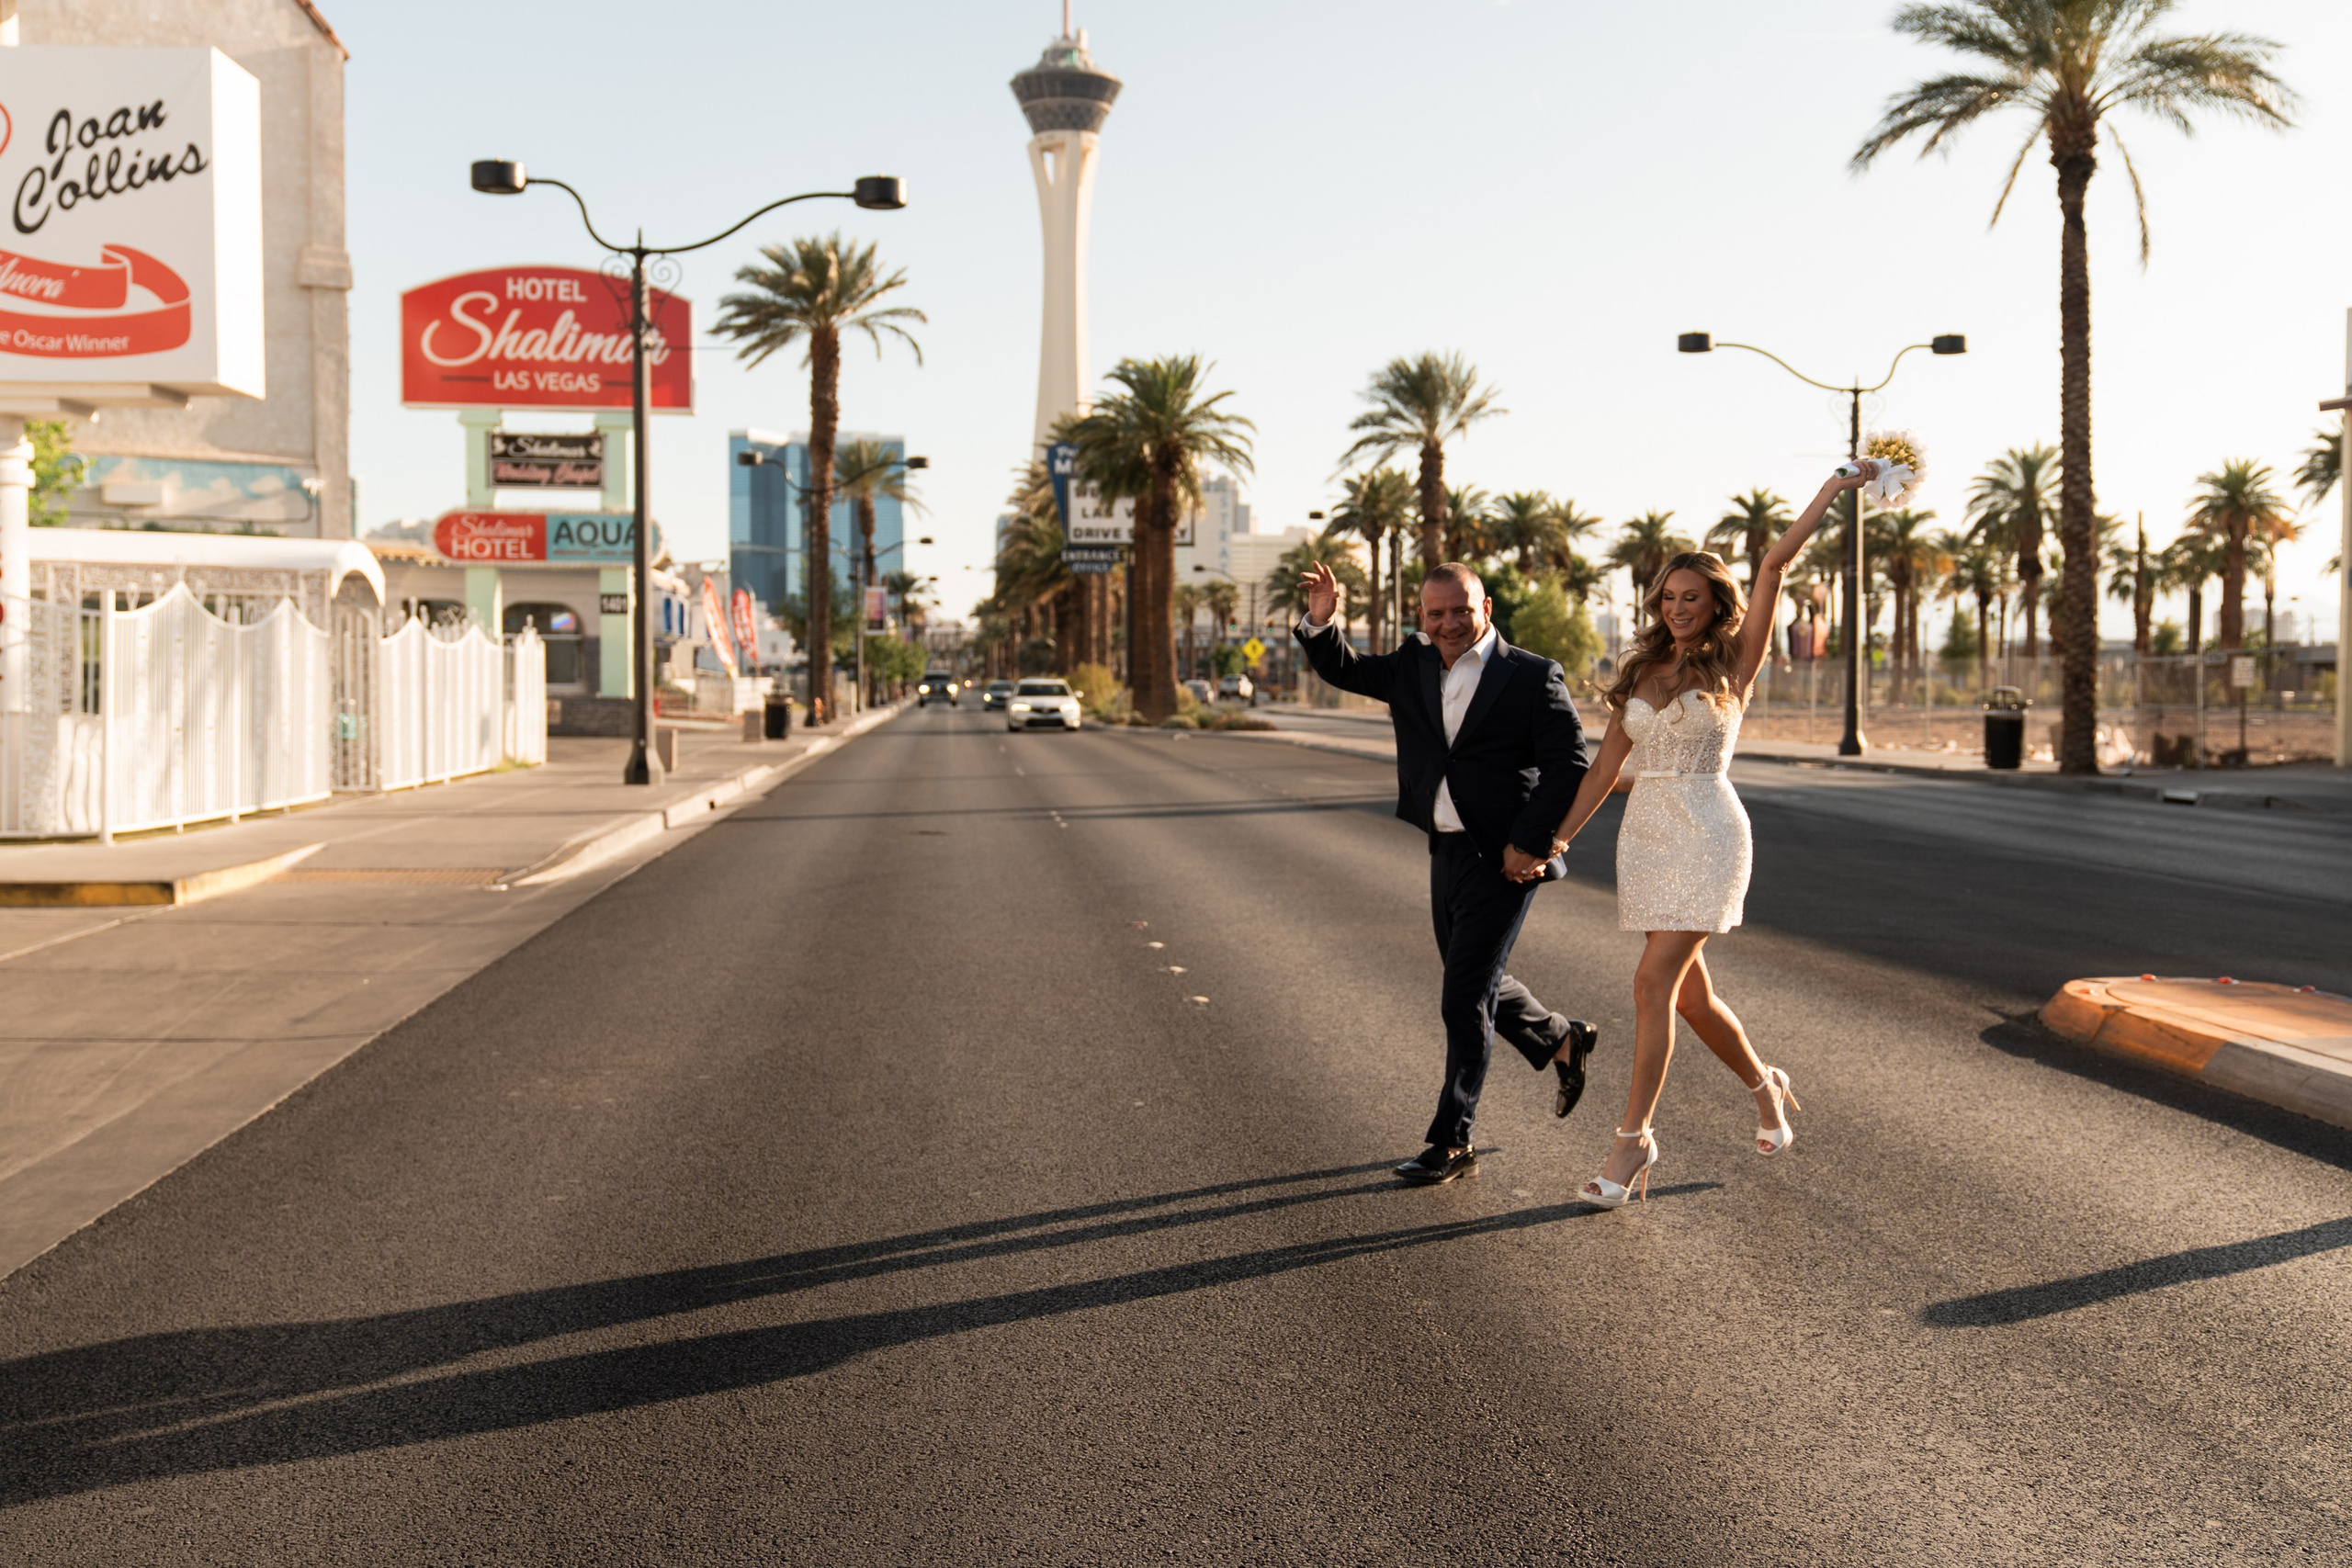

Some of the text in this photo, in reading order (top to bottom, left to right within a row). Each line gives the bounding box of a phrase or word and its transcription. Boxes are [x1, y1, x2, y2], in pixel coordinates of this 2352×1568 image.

[45, 98, 168, 181] Joan
[13, 143, 209, 234] Collins
[506, 277, 587, 302] HOTEL
[14, 329, 63, 352] Oscar
[65, 333, 130, 353] Winner
[493, 370, 601, 392] LAS VEGAS
[451, 514, 536, 540] Shalimar
[1073, 527, 1121, 540] DRIVE
[451, 538, 535, 559] HOTEL
[1060, 549, 1121, 562] ENTRANCE
